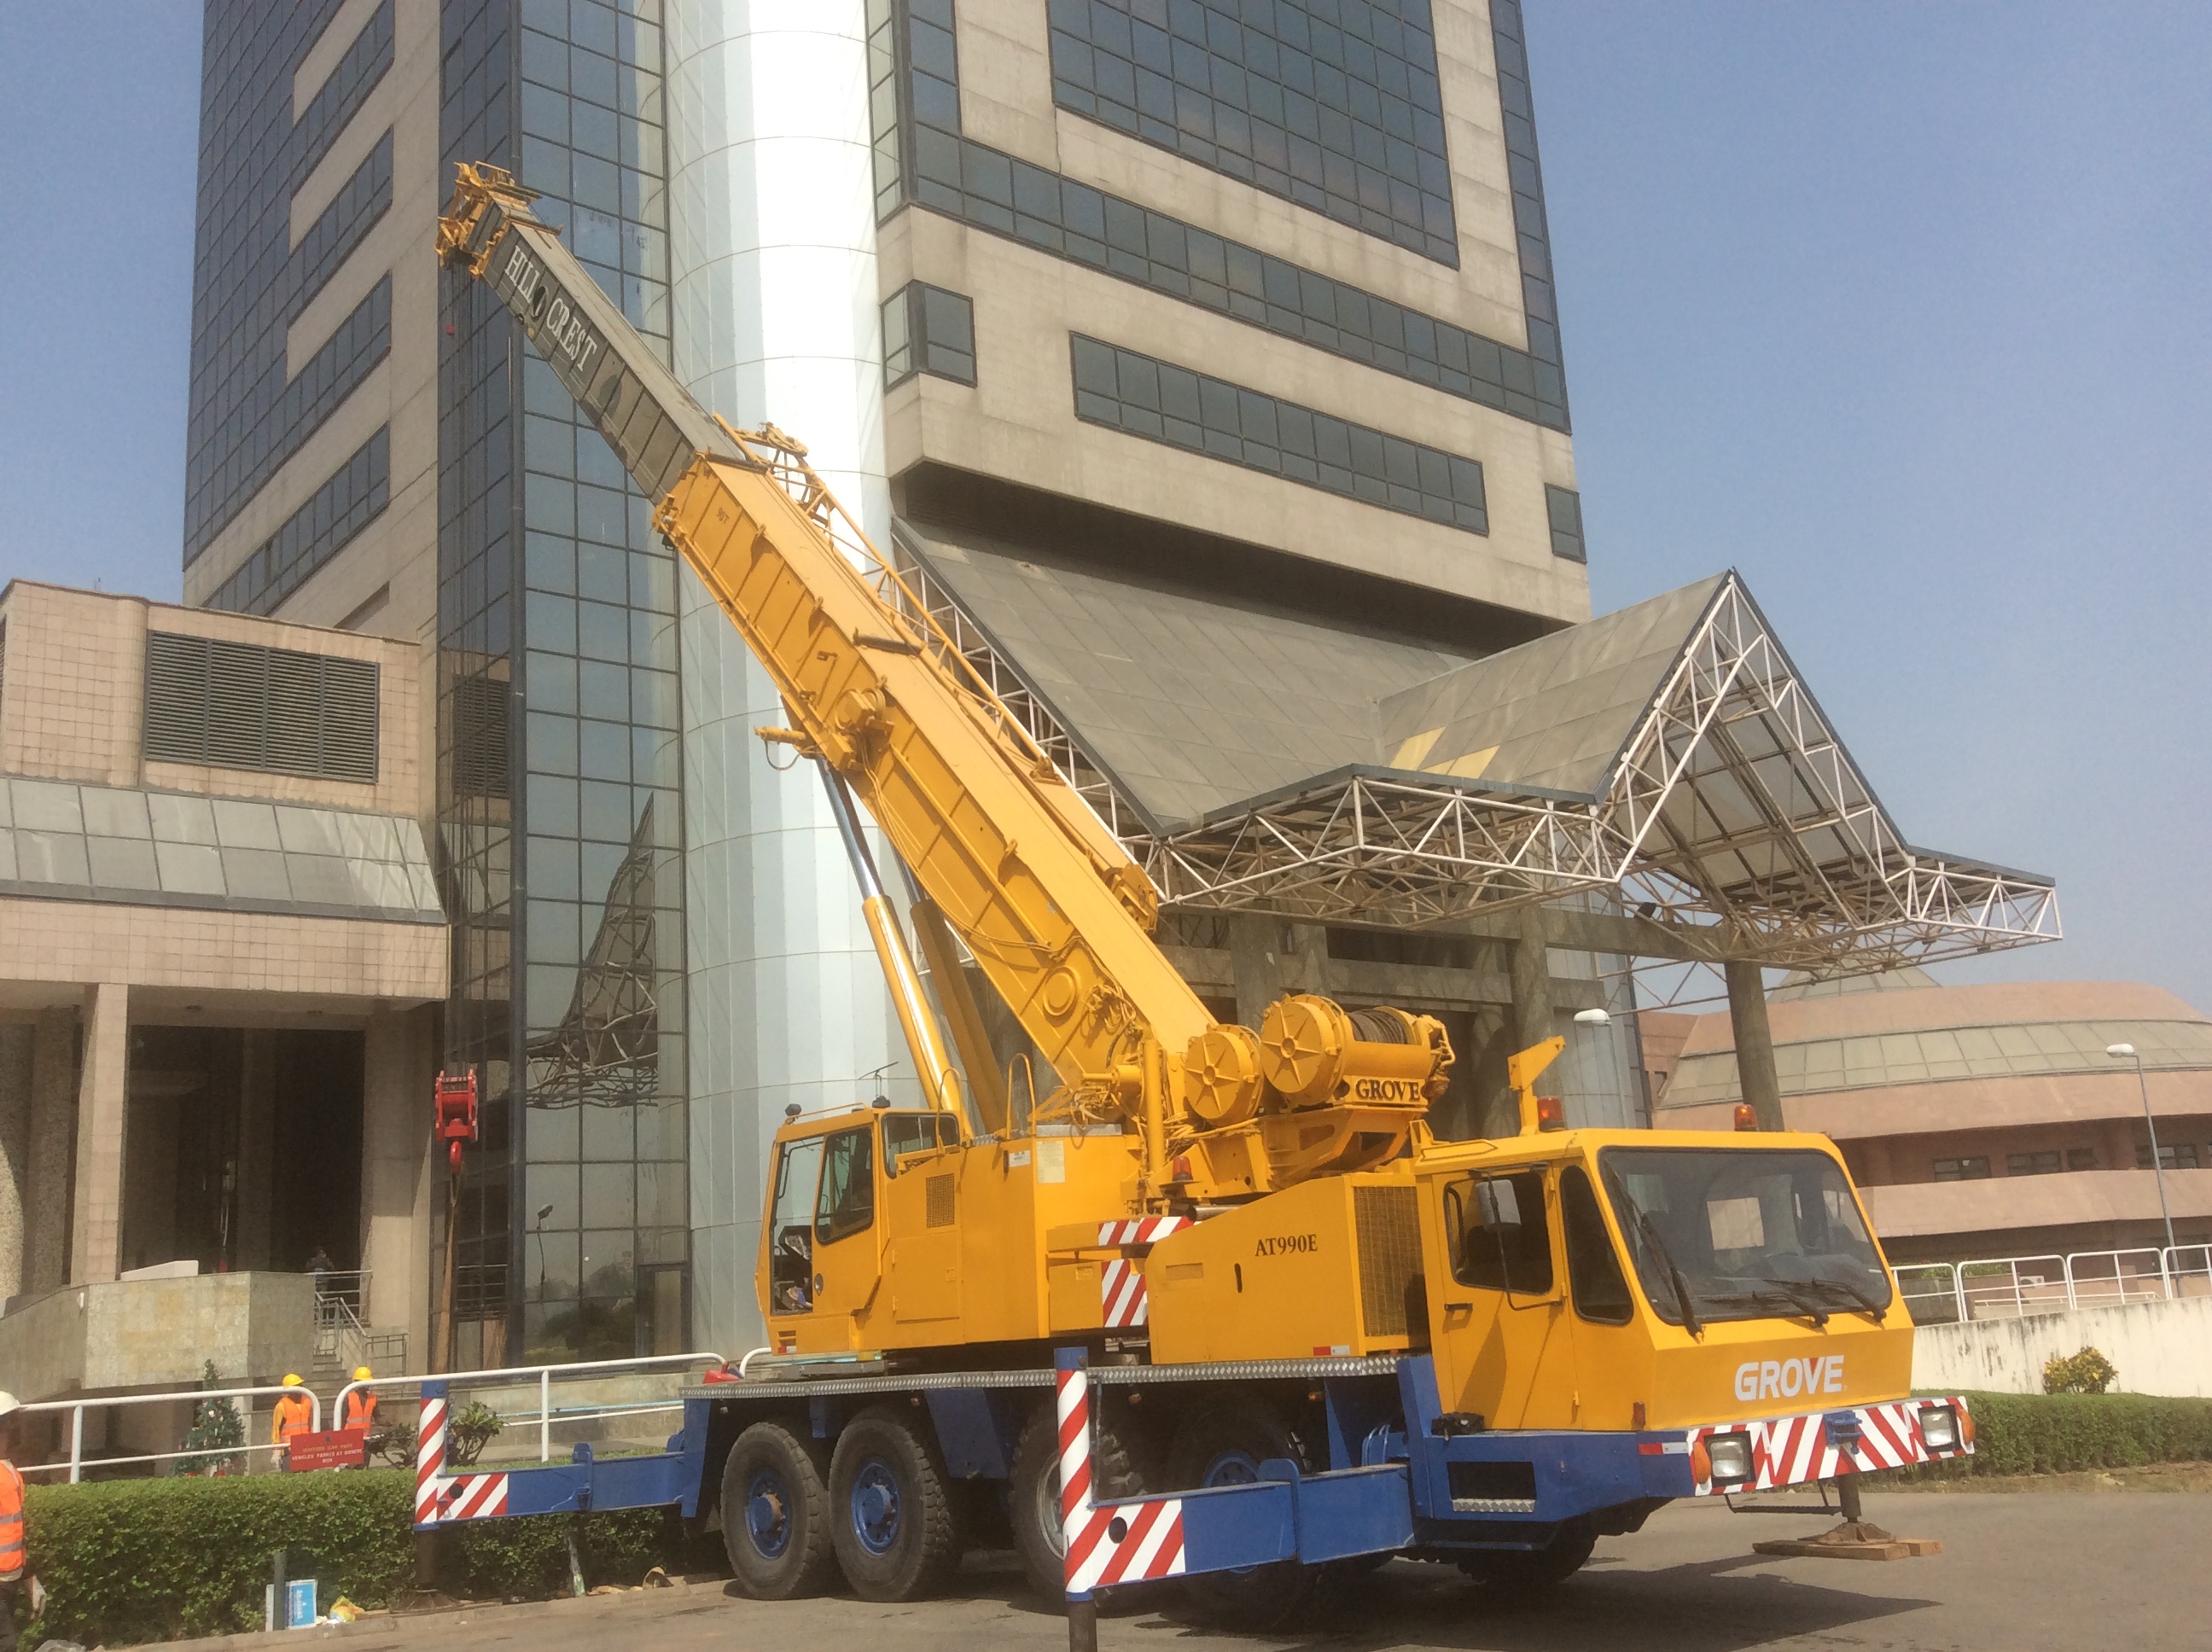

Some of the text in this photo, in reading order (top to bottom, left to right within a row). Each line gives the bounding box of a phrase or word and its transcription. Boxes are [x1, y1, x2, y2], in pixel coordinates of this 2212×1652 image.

[546, 298, 597, 371] CREST
[1355, 1079, 1420, 1102] GROVE
[1254, 1234, 1318, 1257] AT990E
[1735, 1354, 1844, 1401] GROVE
